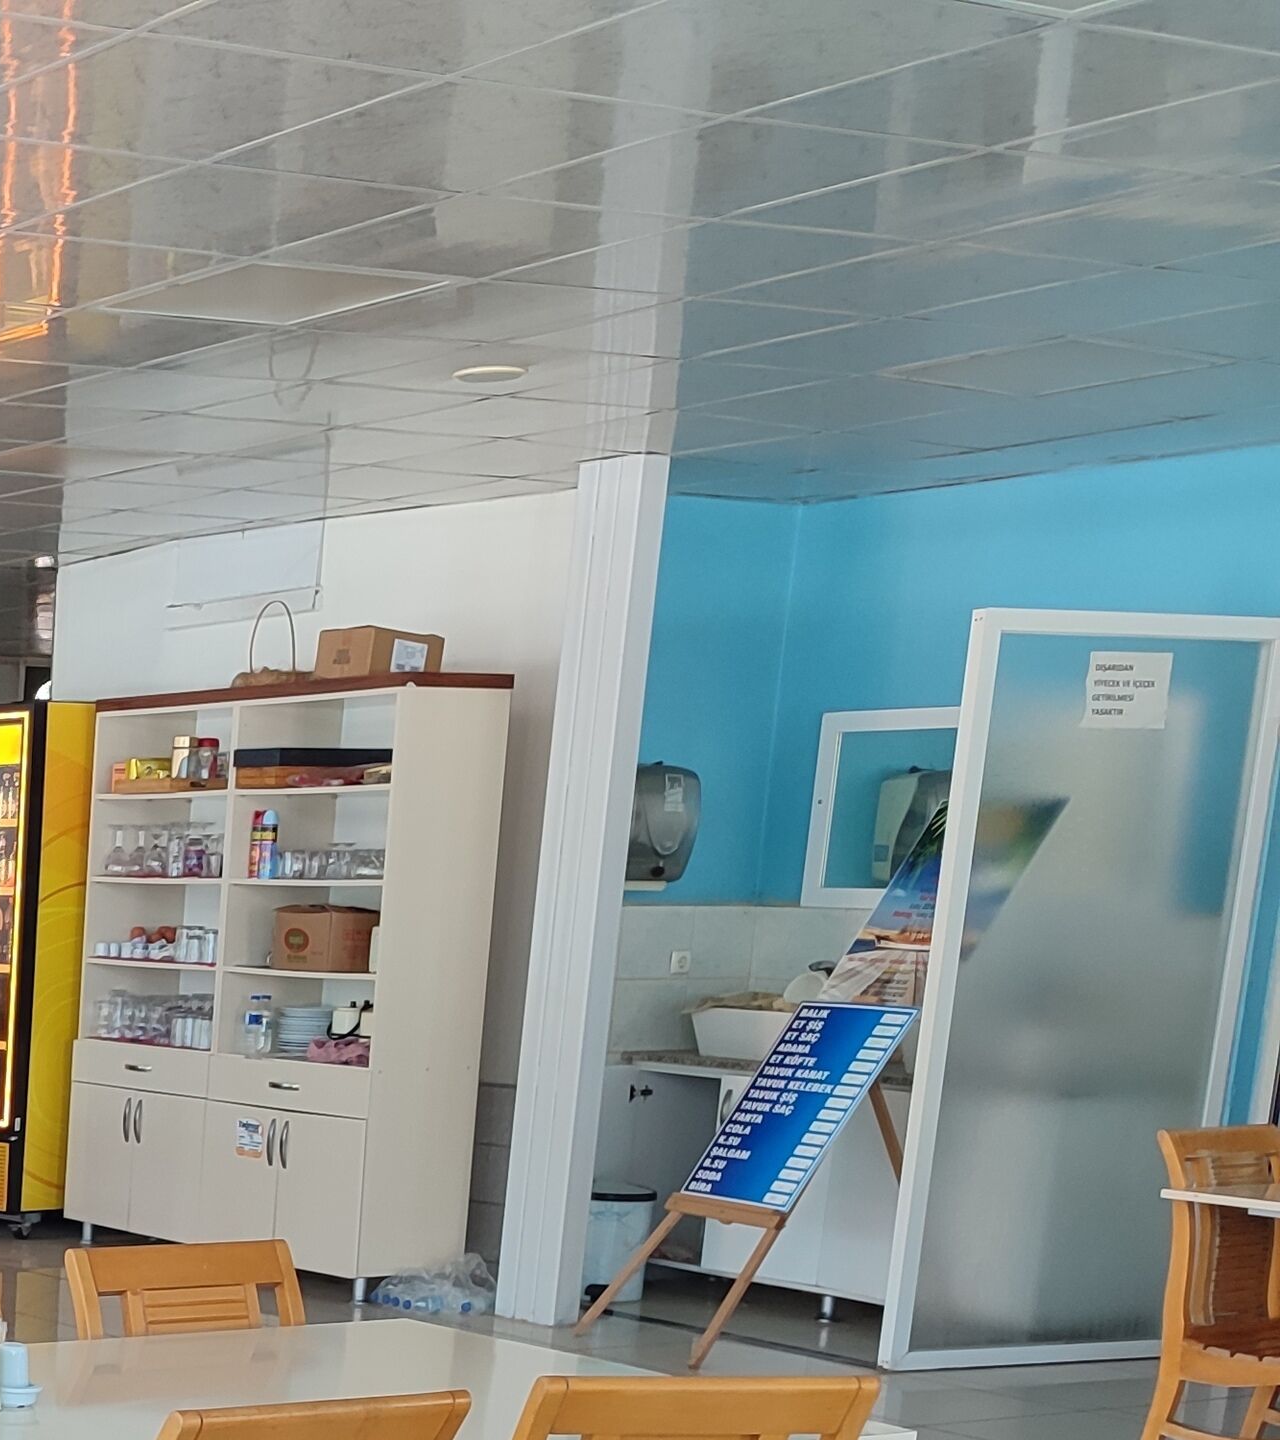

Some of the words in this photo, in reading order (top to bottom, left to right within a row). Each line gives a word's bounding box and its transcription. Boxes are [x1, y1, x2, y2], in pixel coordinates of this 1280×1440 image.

[799, 1008, 831, 1019] BALIK
[791, 1020, 807, 1029] ET
[806, 1019, 825, 1032] ŞİŞ
[784, 1031, 799, 1041] ET
[798, 1032, 821, 1044] SAÇ
[776, 1042, 811, 1053] ADANA
[768, 1054, 785, 1064] ET
[783, 1054, 818, 1067] KÖFTE
[762, 1066, 796, 1077] TAVUK
[794, 1068, 831, 1080] KANAT
[755, 1077, 788, 1089] TAVUK
[787, 1080, 835, 1094] KELEBEK
[747, 1089, 780, 1100] TAVUK
[779, 1091, 799, 1104] ŞİŞ
[740, 1100, 773, 1112] TAVUK
[772, 1103, 795, 1117] SAÇ
[731, 1111, 763, 1124] FANTA
[724, 1123, 752, 1135] COLA
[710, 1146, 752, 1160] ŞALGAM
[695, 1169, 722, 1181] SODA
[688, 1180, 713, 1192] BİRA
